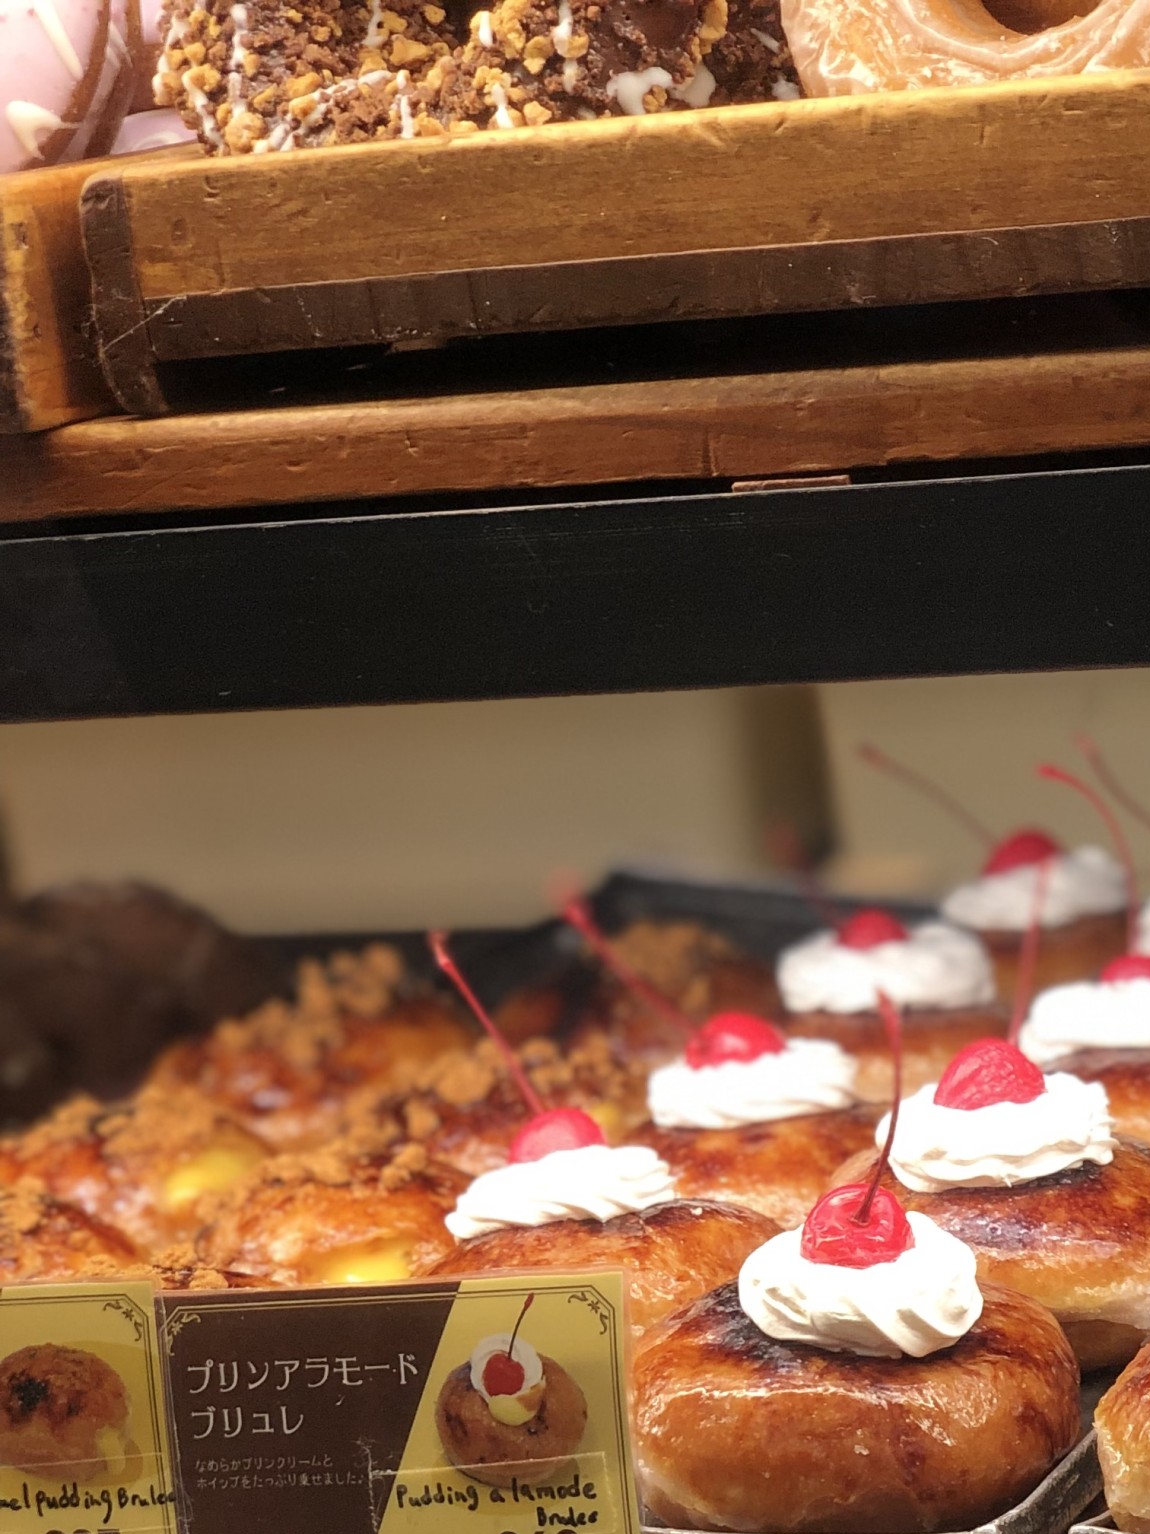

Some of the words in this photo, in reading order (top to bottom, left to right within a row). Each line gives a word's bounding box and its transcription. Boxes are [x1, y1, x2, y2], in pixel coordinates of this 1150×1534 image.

[187, 1353, 418, 1394] プリンアラモード
[191, 1405, 304, 1439] ブリュレ
